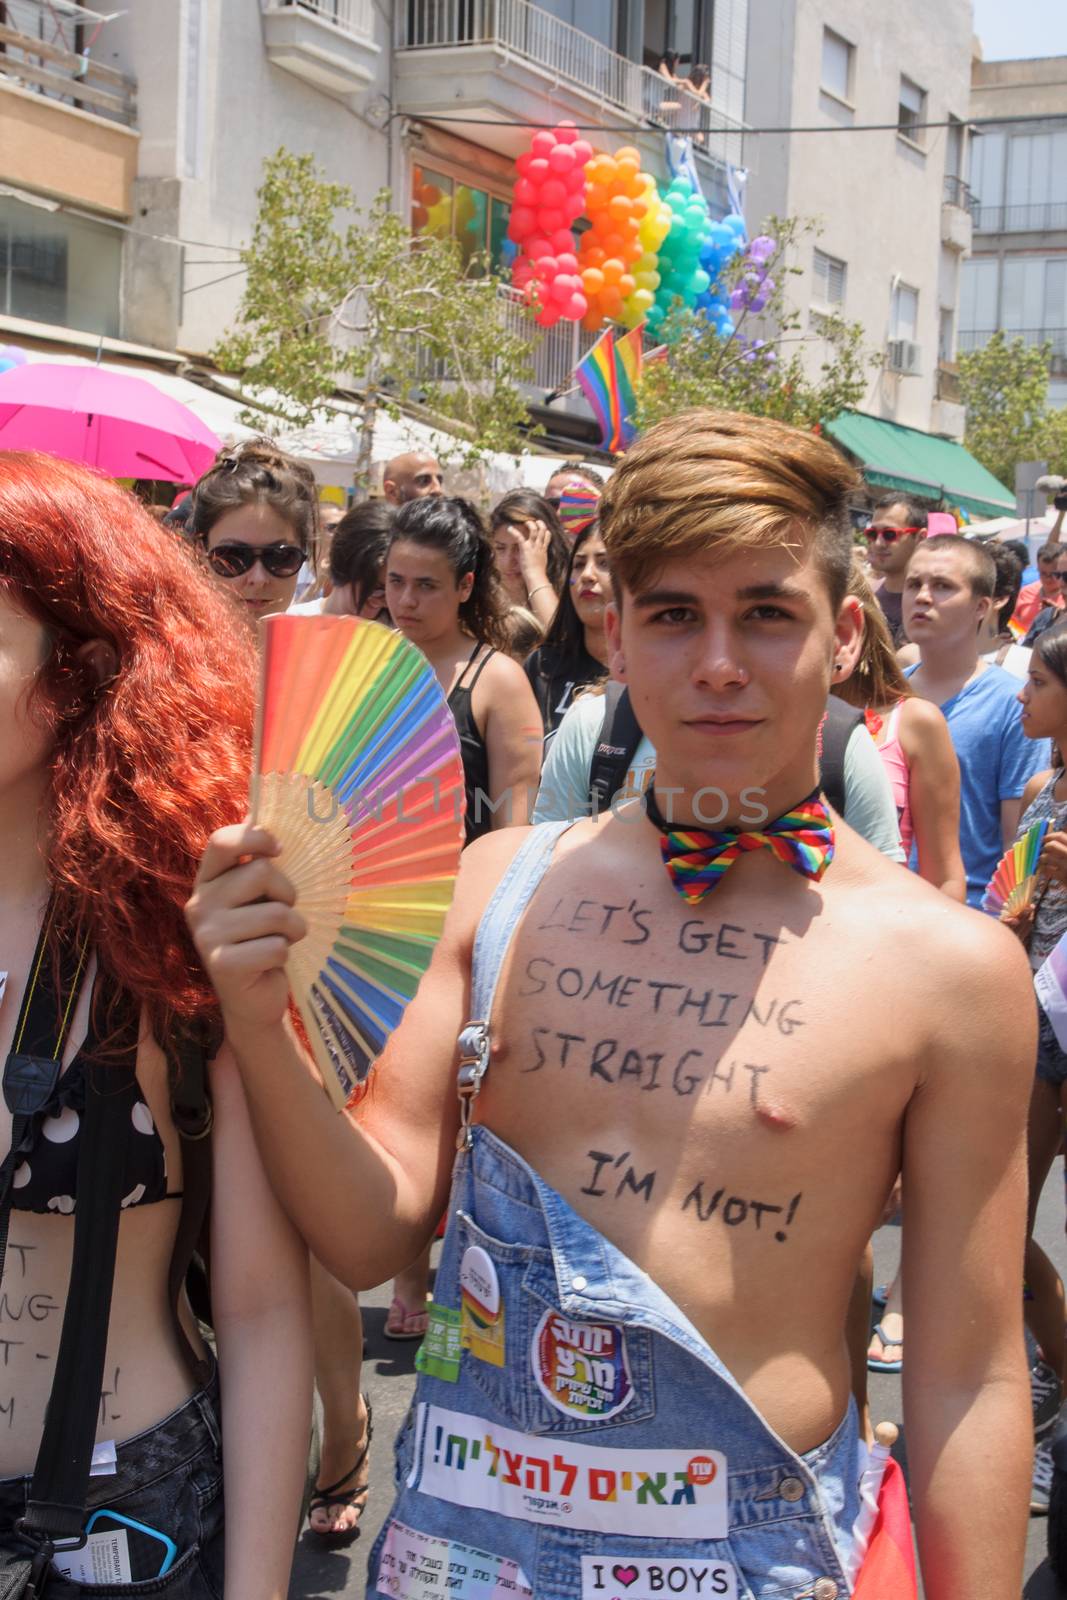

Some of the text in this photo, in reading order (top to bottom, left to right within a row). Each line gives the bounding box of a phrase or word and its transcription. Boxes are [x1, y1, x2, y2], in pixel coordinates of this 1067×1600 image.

[538, 899, 787, 964] LET'S GET
[519, 958, 806, 1036] SOMETHING
[521, 1027, 768, 1107] STRAIGHT
[581, 1150, 802, 1242] I'M NOT!
[556, 1346, 615, 1390] מרצ
[433, 1425, 578, 1497] להצליח!
[592, 1565, 728, 1594] I BOYS
